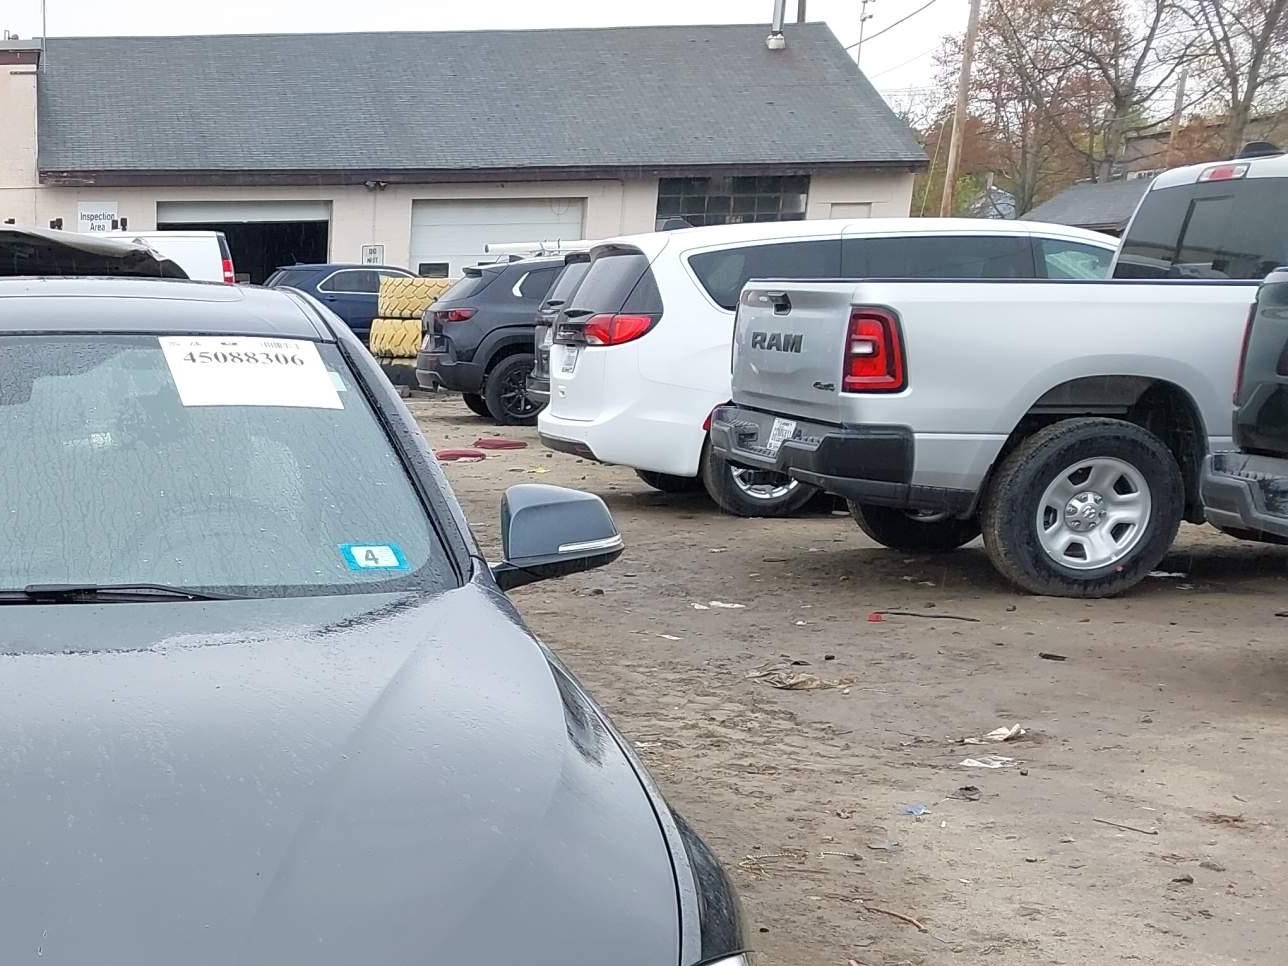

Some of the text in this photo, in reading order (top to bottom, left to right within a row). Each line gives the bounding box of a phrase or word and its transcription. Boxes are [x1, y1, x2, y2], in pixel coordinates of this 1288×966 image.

[80, 211, 115, 222] Inspection
[90, 222, 106, 231] Area
[751, 331, 803, 354] RAM
[183, 350, 305, 367] 45088306
[365, 549, 379, 565] 4
